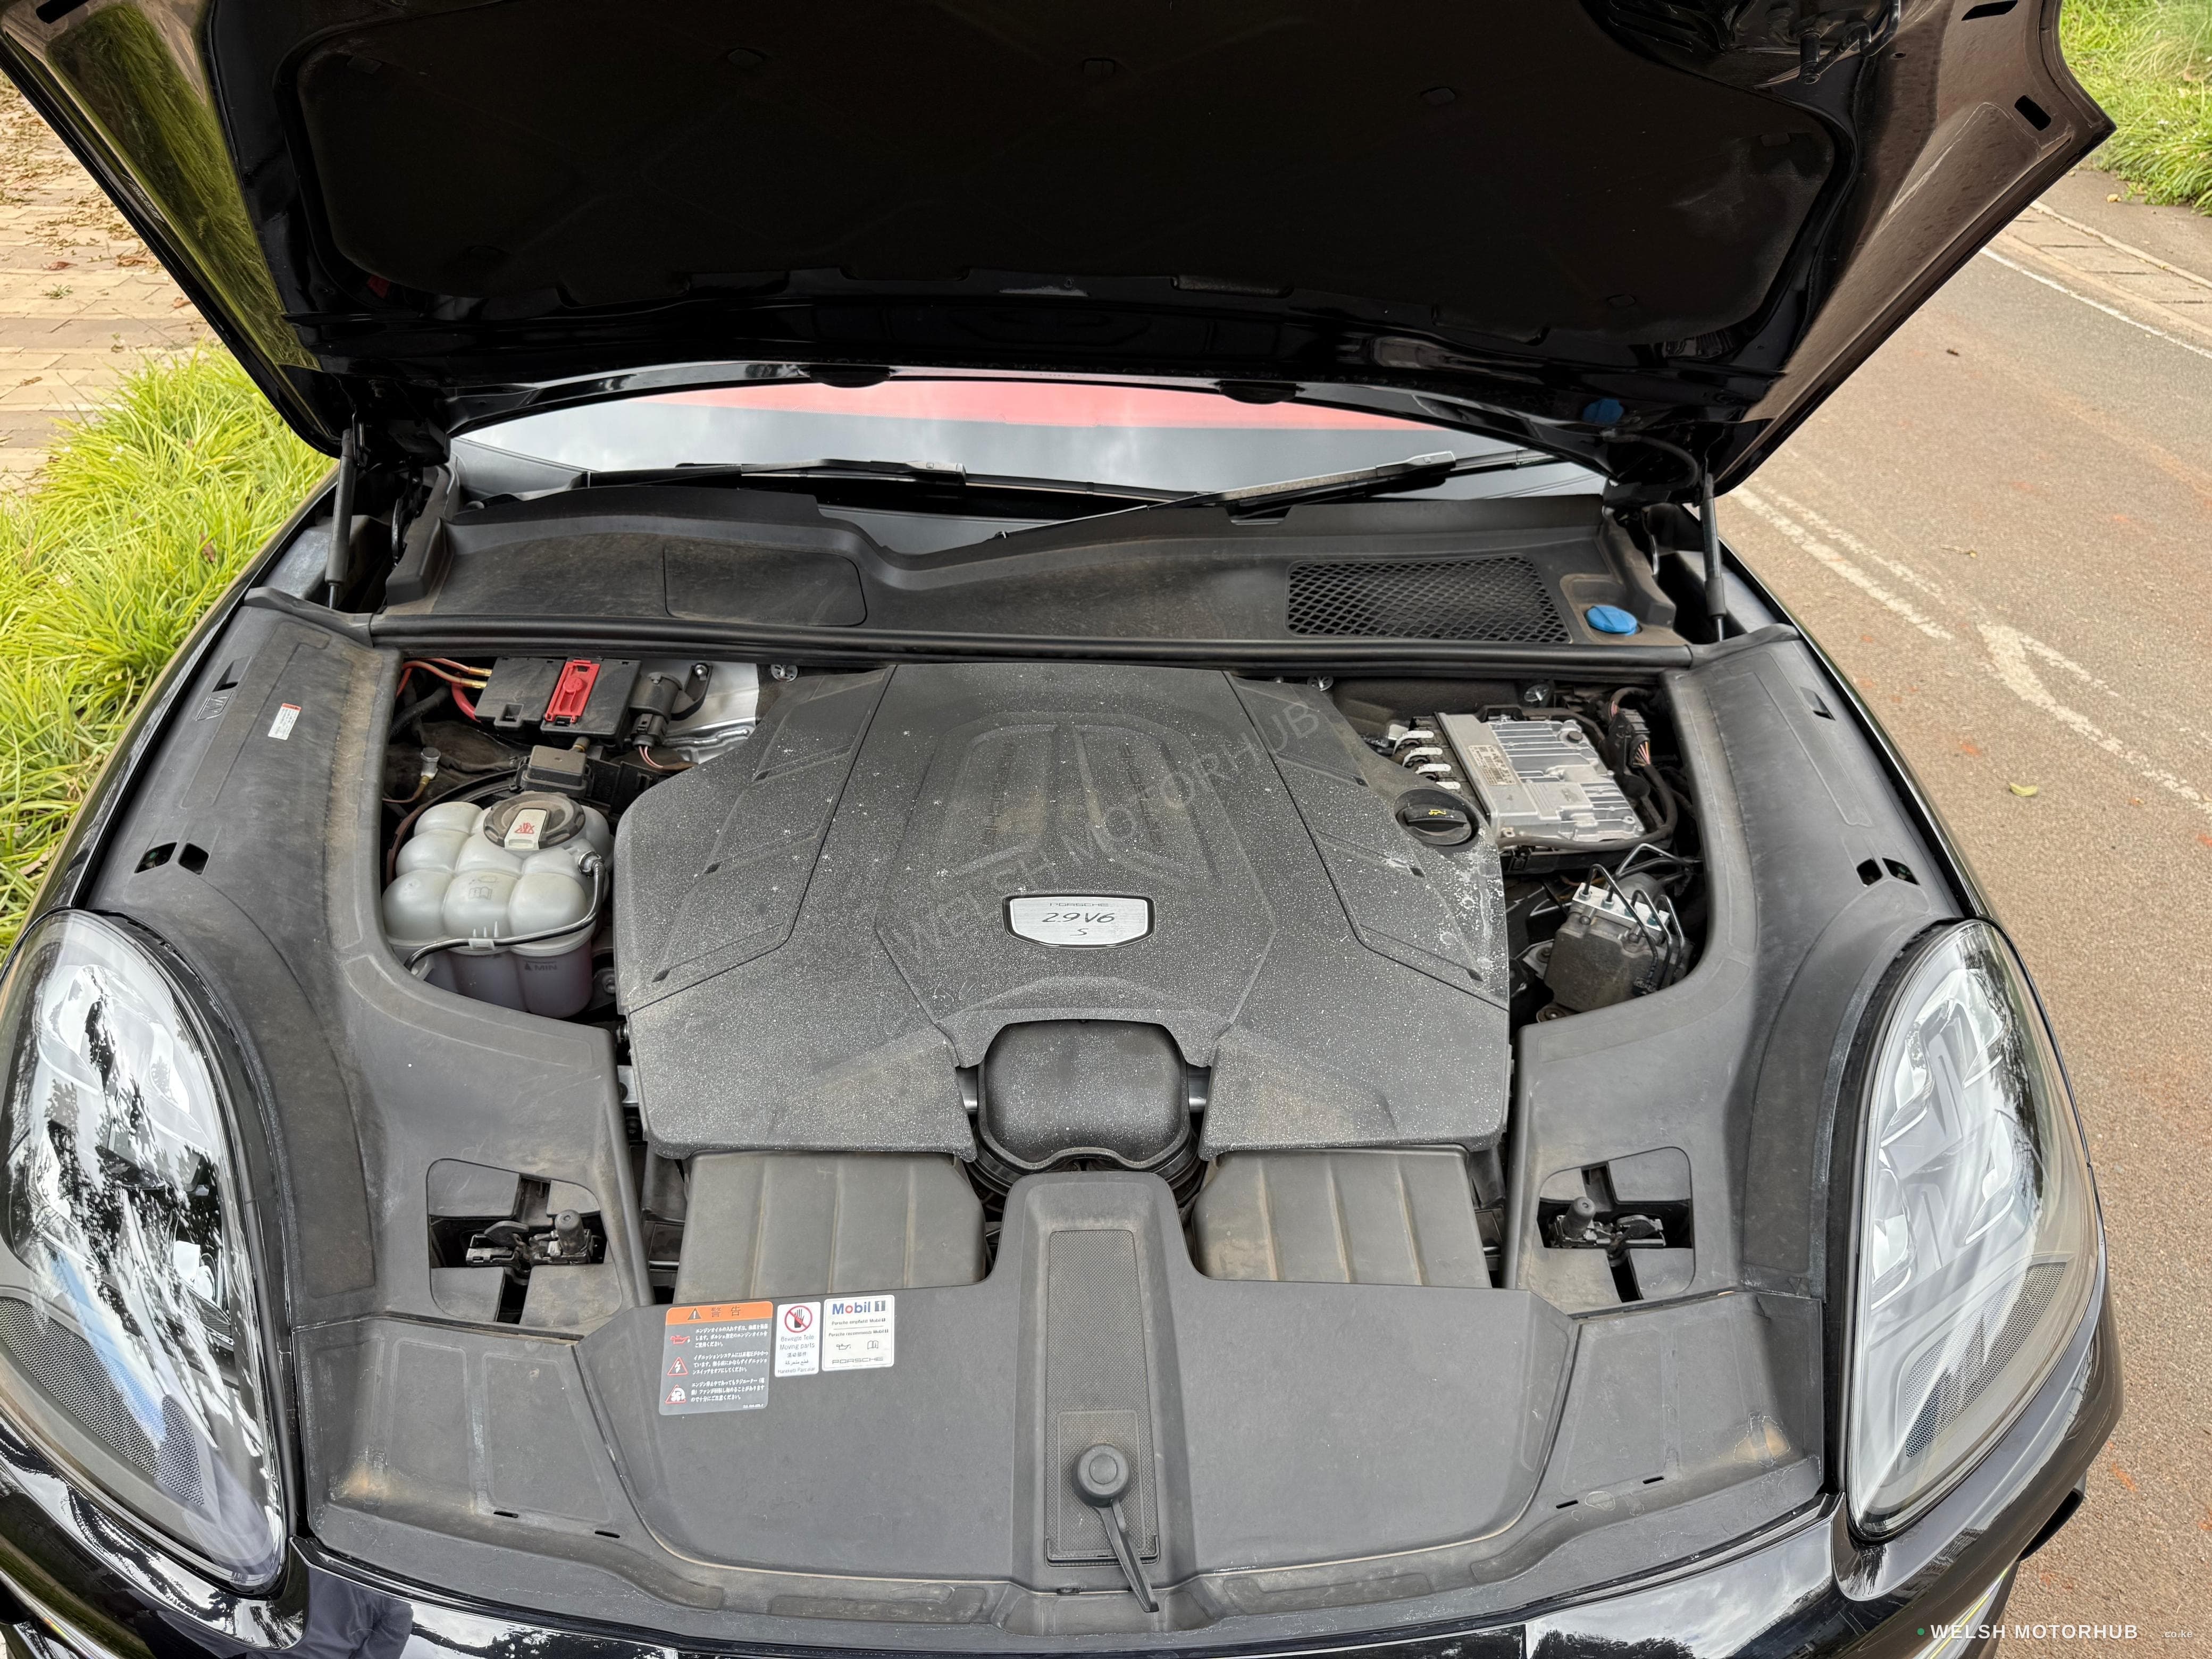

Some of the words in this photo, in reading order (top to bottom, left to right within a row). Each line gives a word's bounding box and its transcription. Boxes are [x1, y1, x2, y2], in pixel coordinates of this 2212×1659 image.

[1070, 928, 1090, 936] S
[711, 1305, 741, 1318] 警告
[832, 1301, 870, 1314] Mobil
